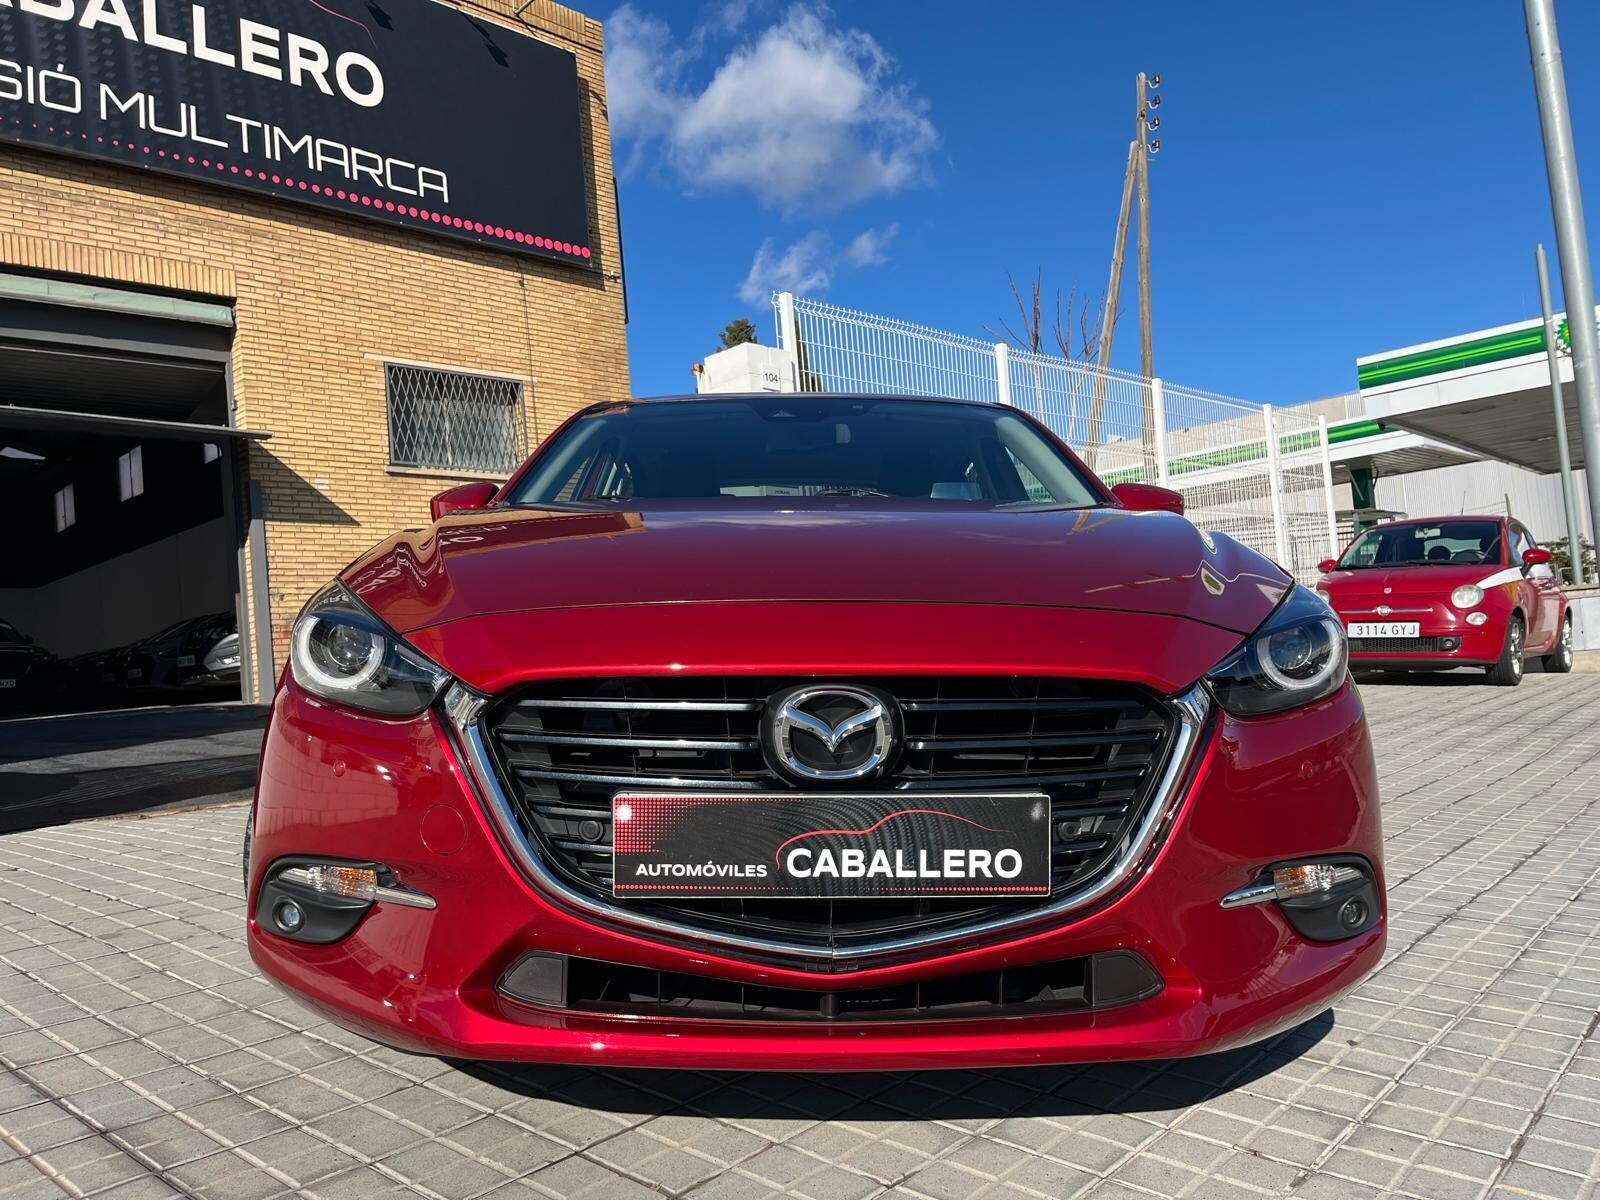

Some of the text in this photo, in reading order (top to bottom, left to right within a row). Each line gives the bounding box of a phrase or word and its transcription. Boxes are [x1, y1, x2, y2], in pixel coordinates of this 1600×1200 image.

[0, 0, 384, 107] ALLERO
[99, 83, 449, 203] MULTIMARCA
[764, 372, 779, 383] 104
[1356, 625, 1416, 636] 3114 GYJ
[635, 848, 1023, 879] AUTOMÓVILES CABALLERO
